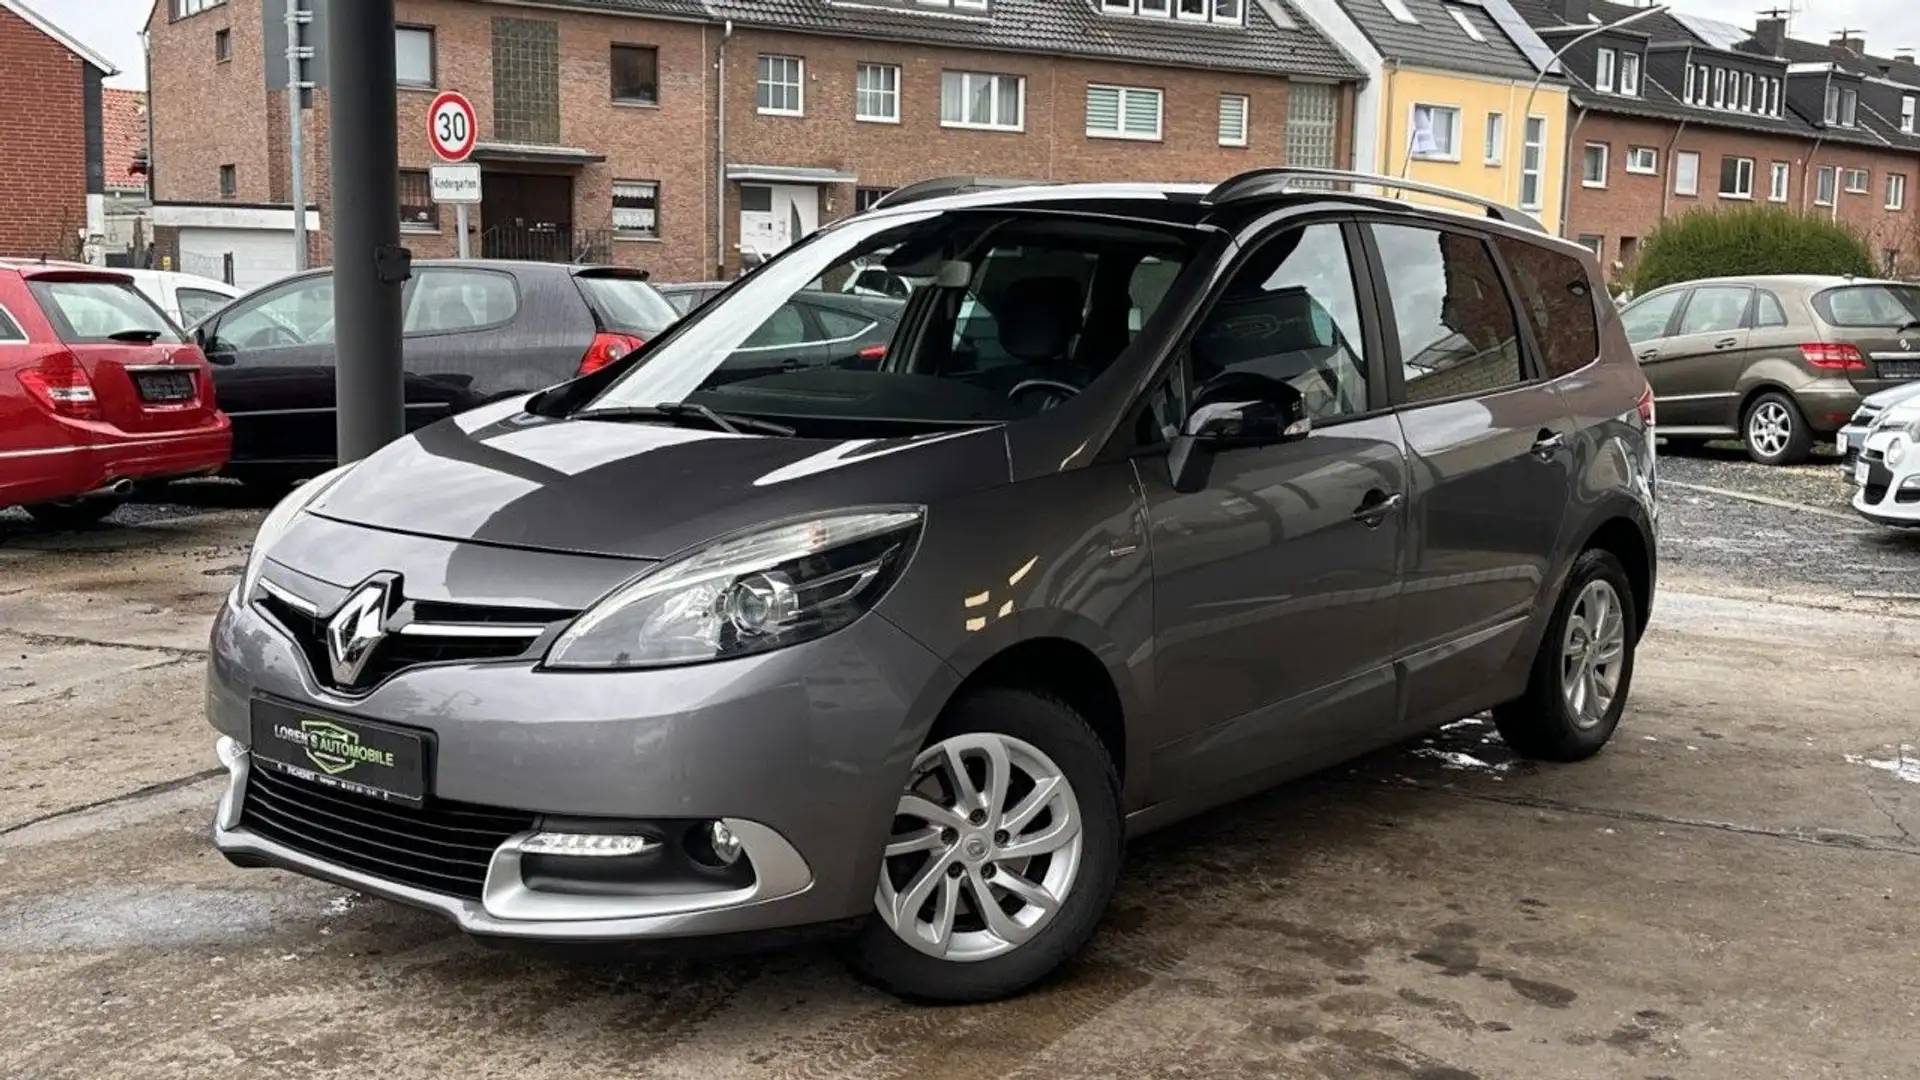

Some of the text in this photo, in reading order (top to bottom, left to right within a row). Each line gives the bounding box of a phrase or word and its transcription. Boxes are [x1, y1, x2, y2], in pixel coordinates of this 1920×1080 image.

[438, 112, 466, 142] 30
[434, 178, 477, 191] Kindergarten
[319, 737, 394, 767] AUTOMOBILE
